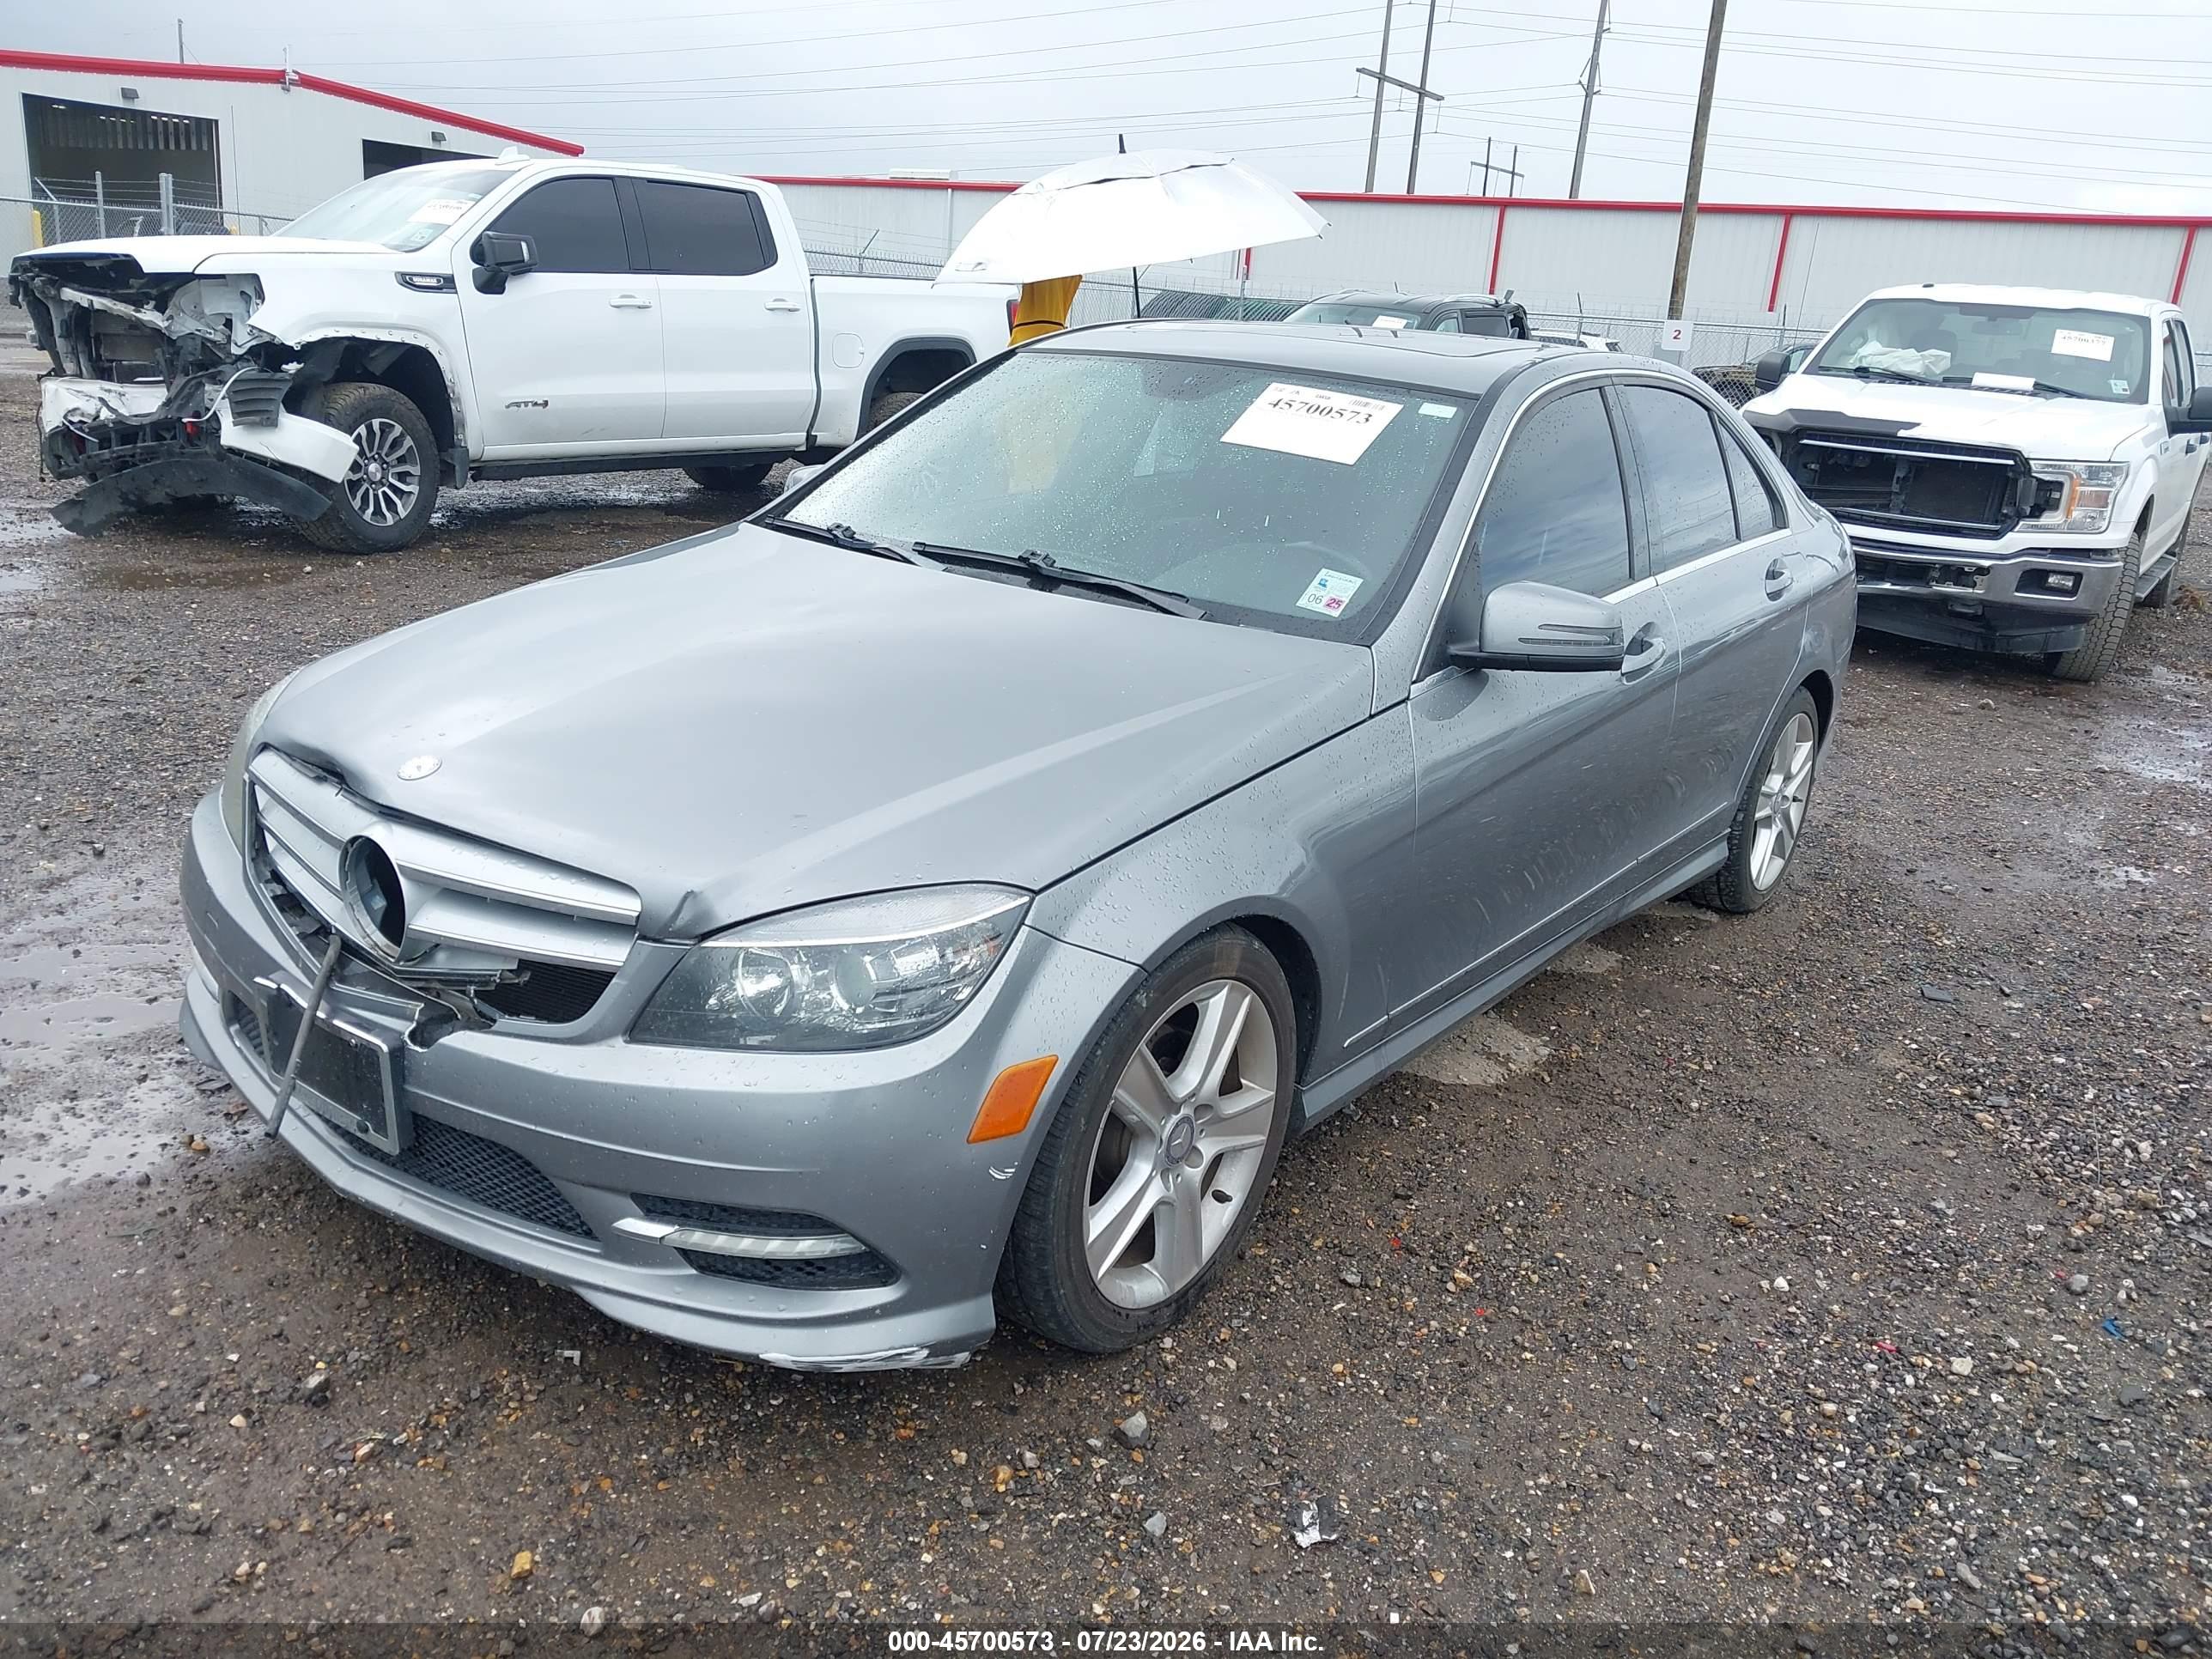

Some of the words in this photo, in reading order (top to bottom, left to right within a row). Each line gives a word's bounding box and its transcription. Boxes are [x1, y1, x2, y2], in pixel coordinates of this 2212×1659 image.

[1672, 329, 1682, 340] 2
[1268, 398, 1373, 424] 45700573
[1307, 593, 1323, 605] 06
[1326, 598, 1343, 610] 25
